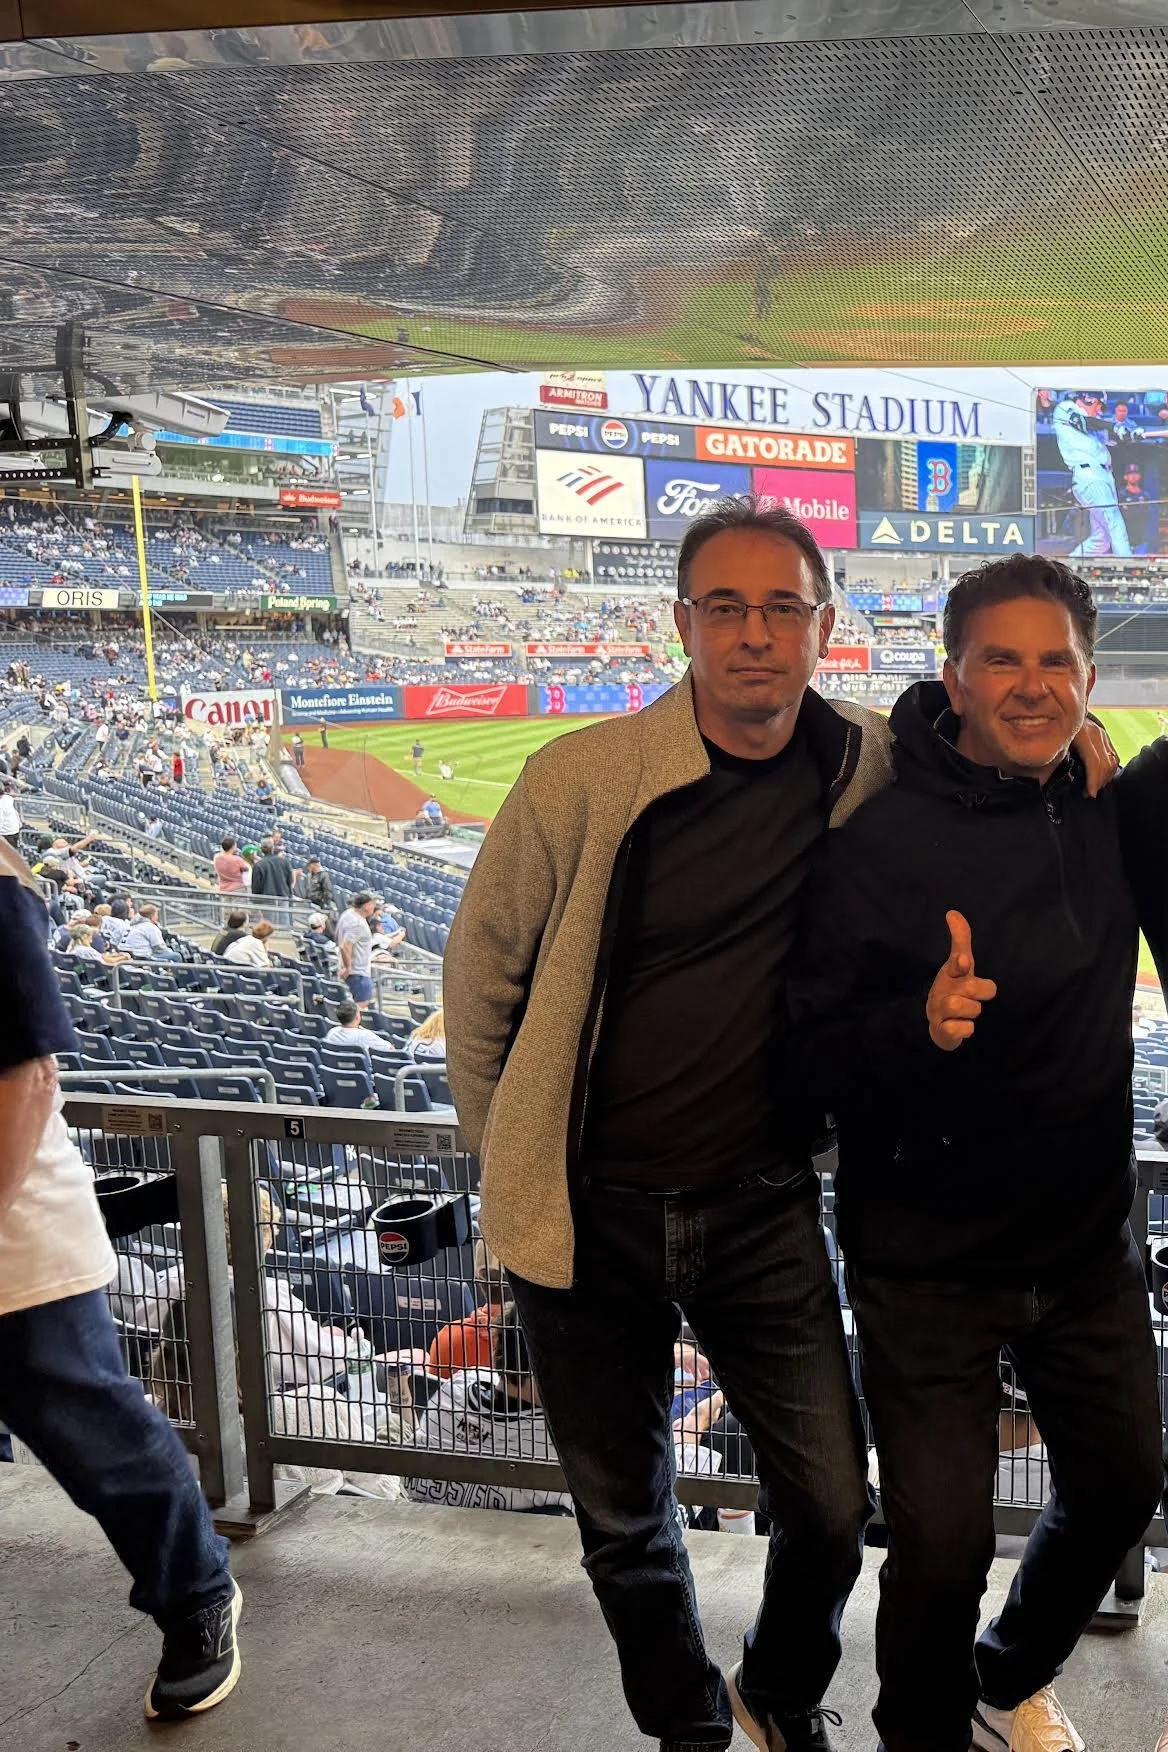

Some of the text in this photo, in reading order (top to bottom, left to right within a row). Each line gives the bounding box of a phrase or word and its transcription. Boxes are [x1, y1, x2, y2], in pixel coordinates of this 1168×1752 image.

[548, 387, 604, 402] ARMITRON
[633, 373, 983, 438] YANKEE STADIUM
[549, 422, 589, 438] PEPSI
[641, 431, 681, 447] PEPSI
[705, 432, 849, 465] GATORADE
[541, 513, 642, 527] BANK OF AMERICA
[912, 518, 1025, 546] DELTA
[56, 590, 103, 606] ORIS
[267, 596, 330, 611] Poland Spring
[894, 651, 926, 664] coupa
[290, 692, 394, 709] Montefiore Einstein
[435, 691, 498, 708] Budweiser
[184, 697, 277, 727] Canon
[290, 1120, 300, 1136] 5
[379, 1241, 408, 1252] PEPSI
